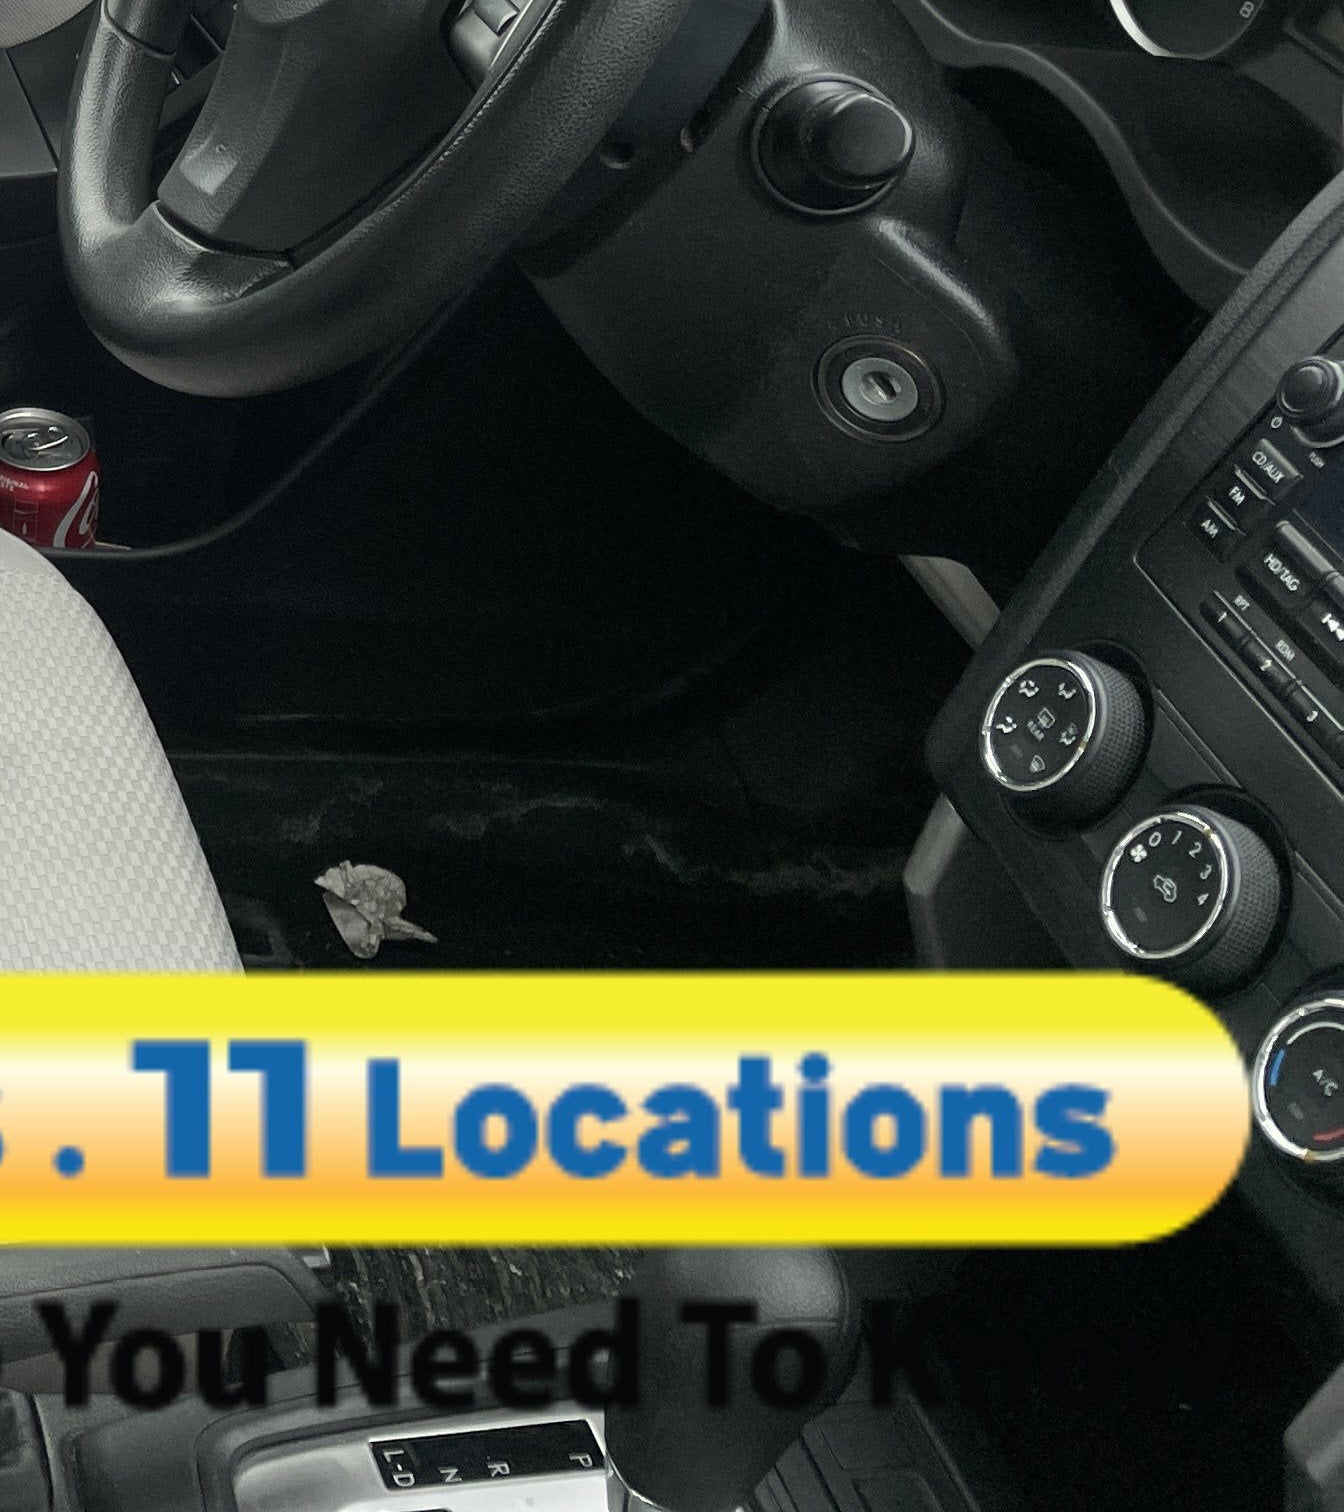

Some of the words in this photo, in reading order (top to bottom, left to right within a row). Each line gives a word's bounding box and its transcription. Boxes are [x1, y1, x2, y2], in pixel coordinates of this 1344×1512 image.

[1252, 451, 1285, 484] CD/AUX
[1228, 486, 1246, 506] FM
[1201, 519, 1219, 538] AM
[1263, 553, 1301, 592] HD/TAG
[1188, 841, 1202, 859] 2
[1313, 1068, 1339, 1097] A/C
[569, 1453, 593, 1468] P
